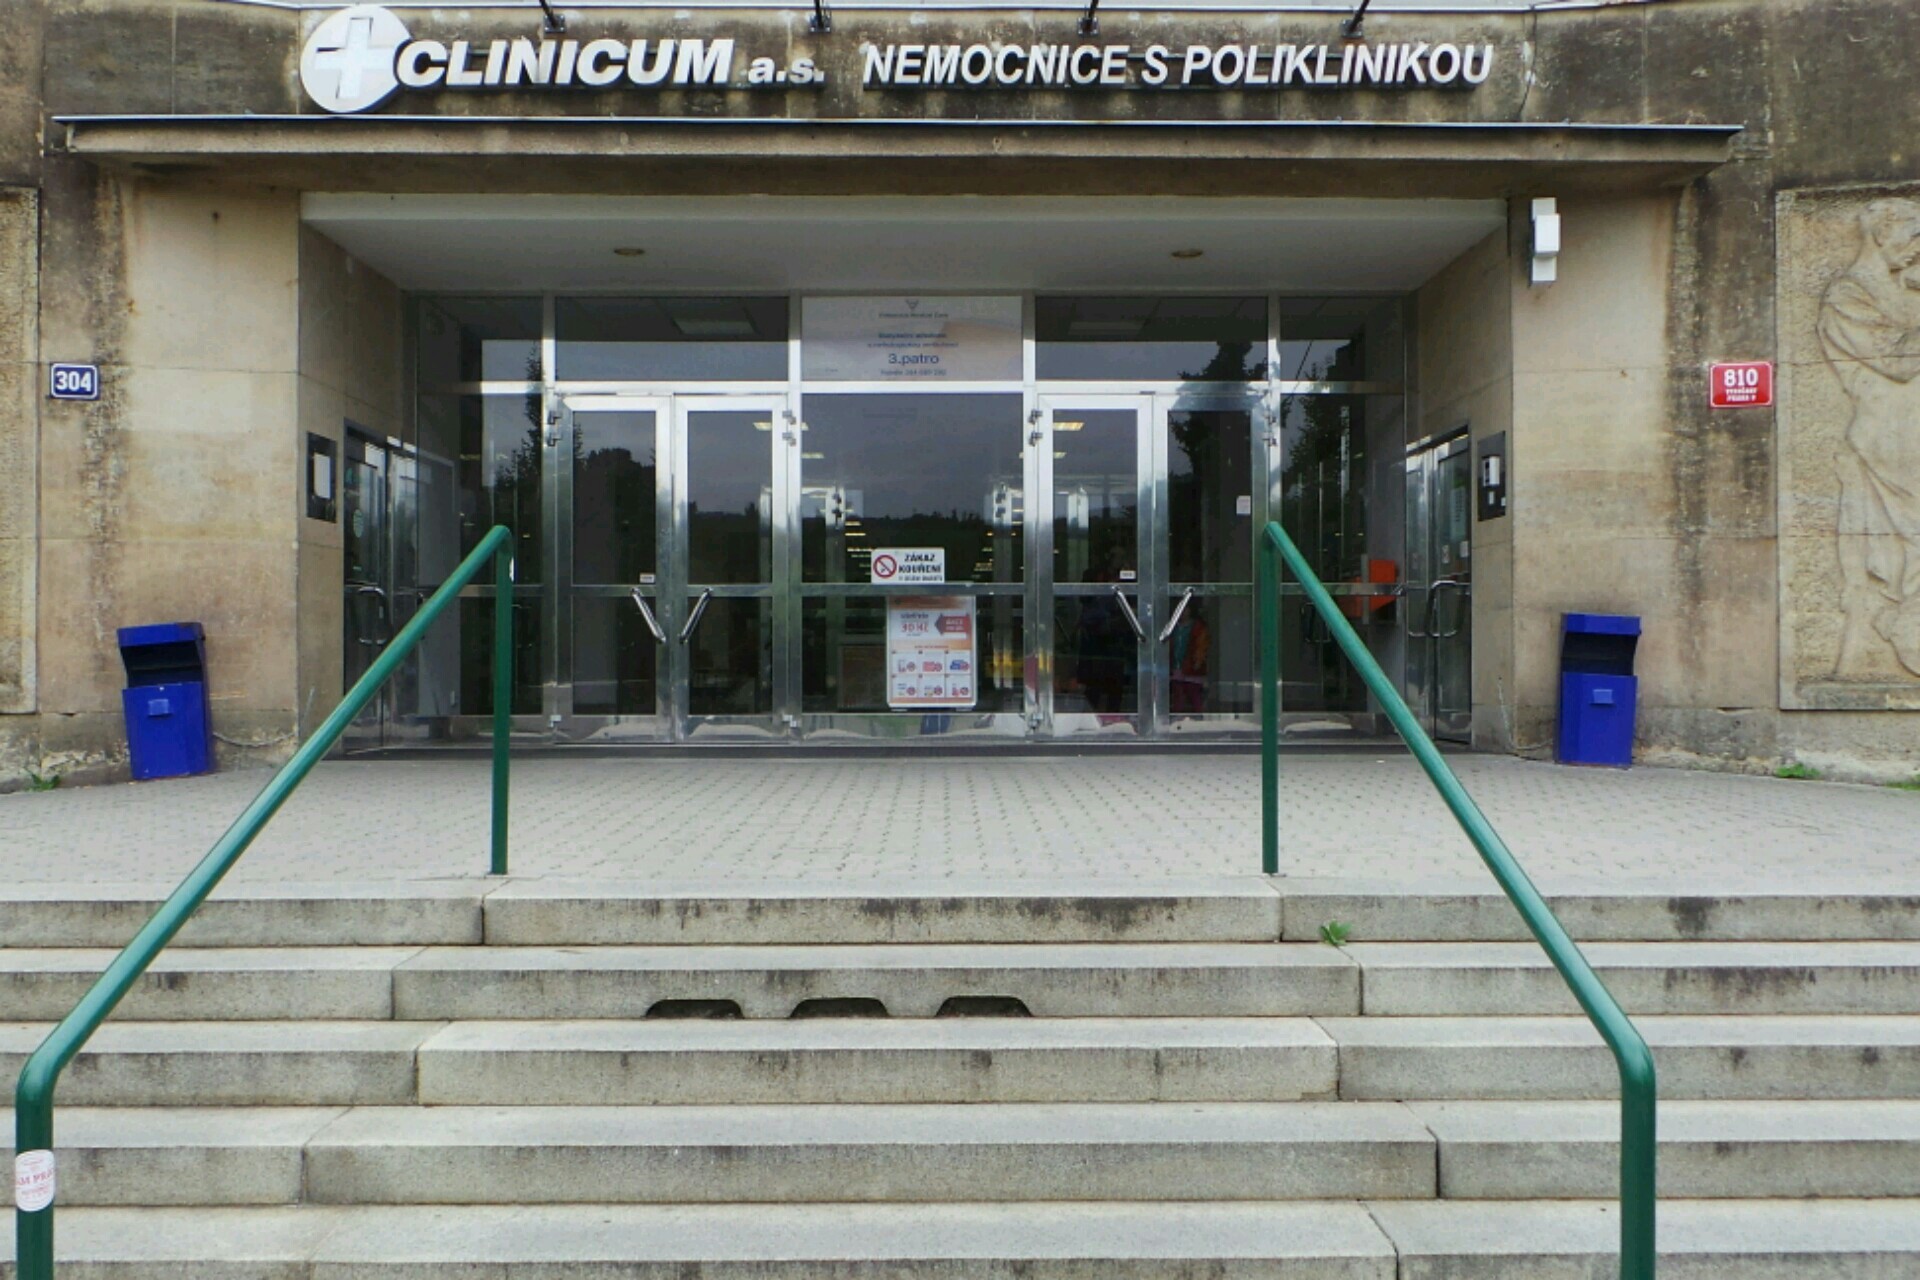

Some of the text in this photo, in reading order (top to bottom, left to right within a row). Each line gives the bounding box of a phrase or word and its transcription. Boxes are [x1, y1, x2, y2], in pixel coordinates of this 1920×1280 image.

[397, 38, 825, 87] CLINICUM a.s.
[863, 43, 1494, 85] NEMOCNICE S POLIKLINIKOU
[888, 352, 939, 366] 3.patro
[56, 370, 92, 392] 304
[1724, 368, 1759, 387] 810
[904, 552, 935, 562] ZÁKAZ
[898, 562, 942, 573] KOUŘENÍ
